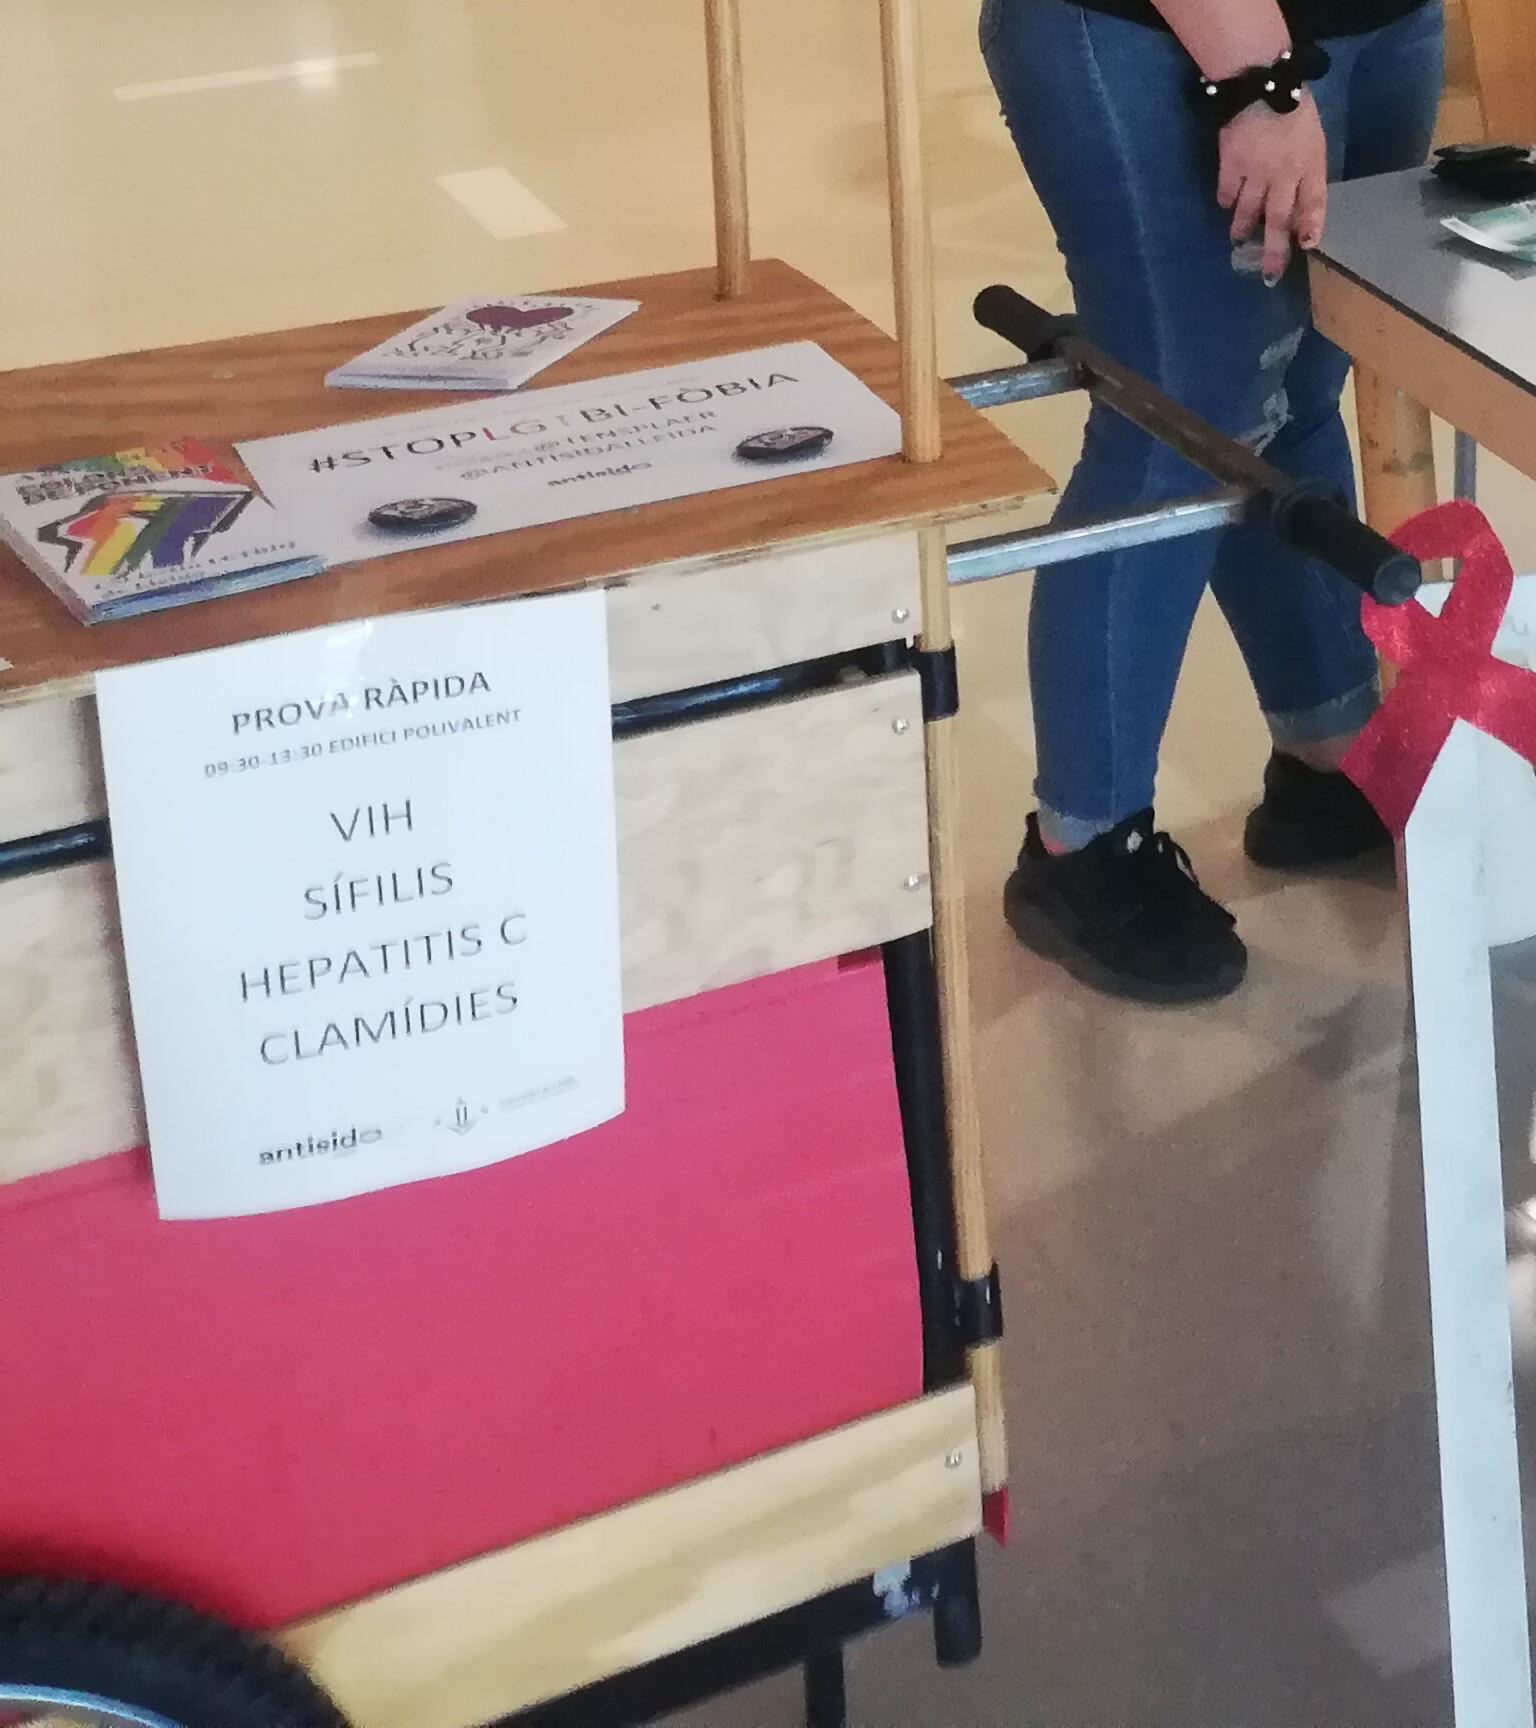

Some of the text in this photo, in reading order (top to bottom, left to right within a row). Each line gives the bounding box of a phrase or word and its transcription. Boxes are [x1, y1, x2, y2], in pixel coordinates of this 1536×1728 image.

[232, 671, 493, 736] PROVA RÀPIDA
[329, 730, 398, 755] EDIFICI
[403, 709, 523, 742] POLIVALENT
[329, 796, 414, 843] VIH
[303, 860, 454, 921] SÍFILIS
[240, 911, 528, 1004] HEPATITIS C
[259, 980, 520, 1066] CLAMÍDIES
